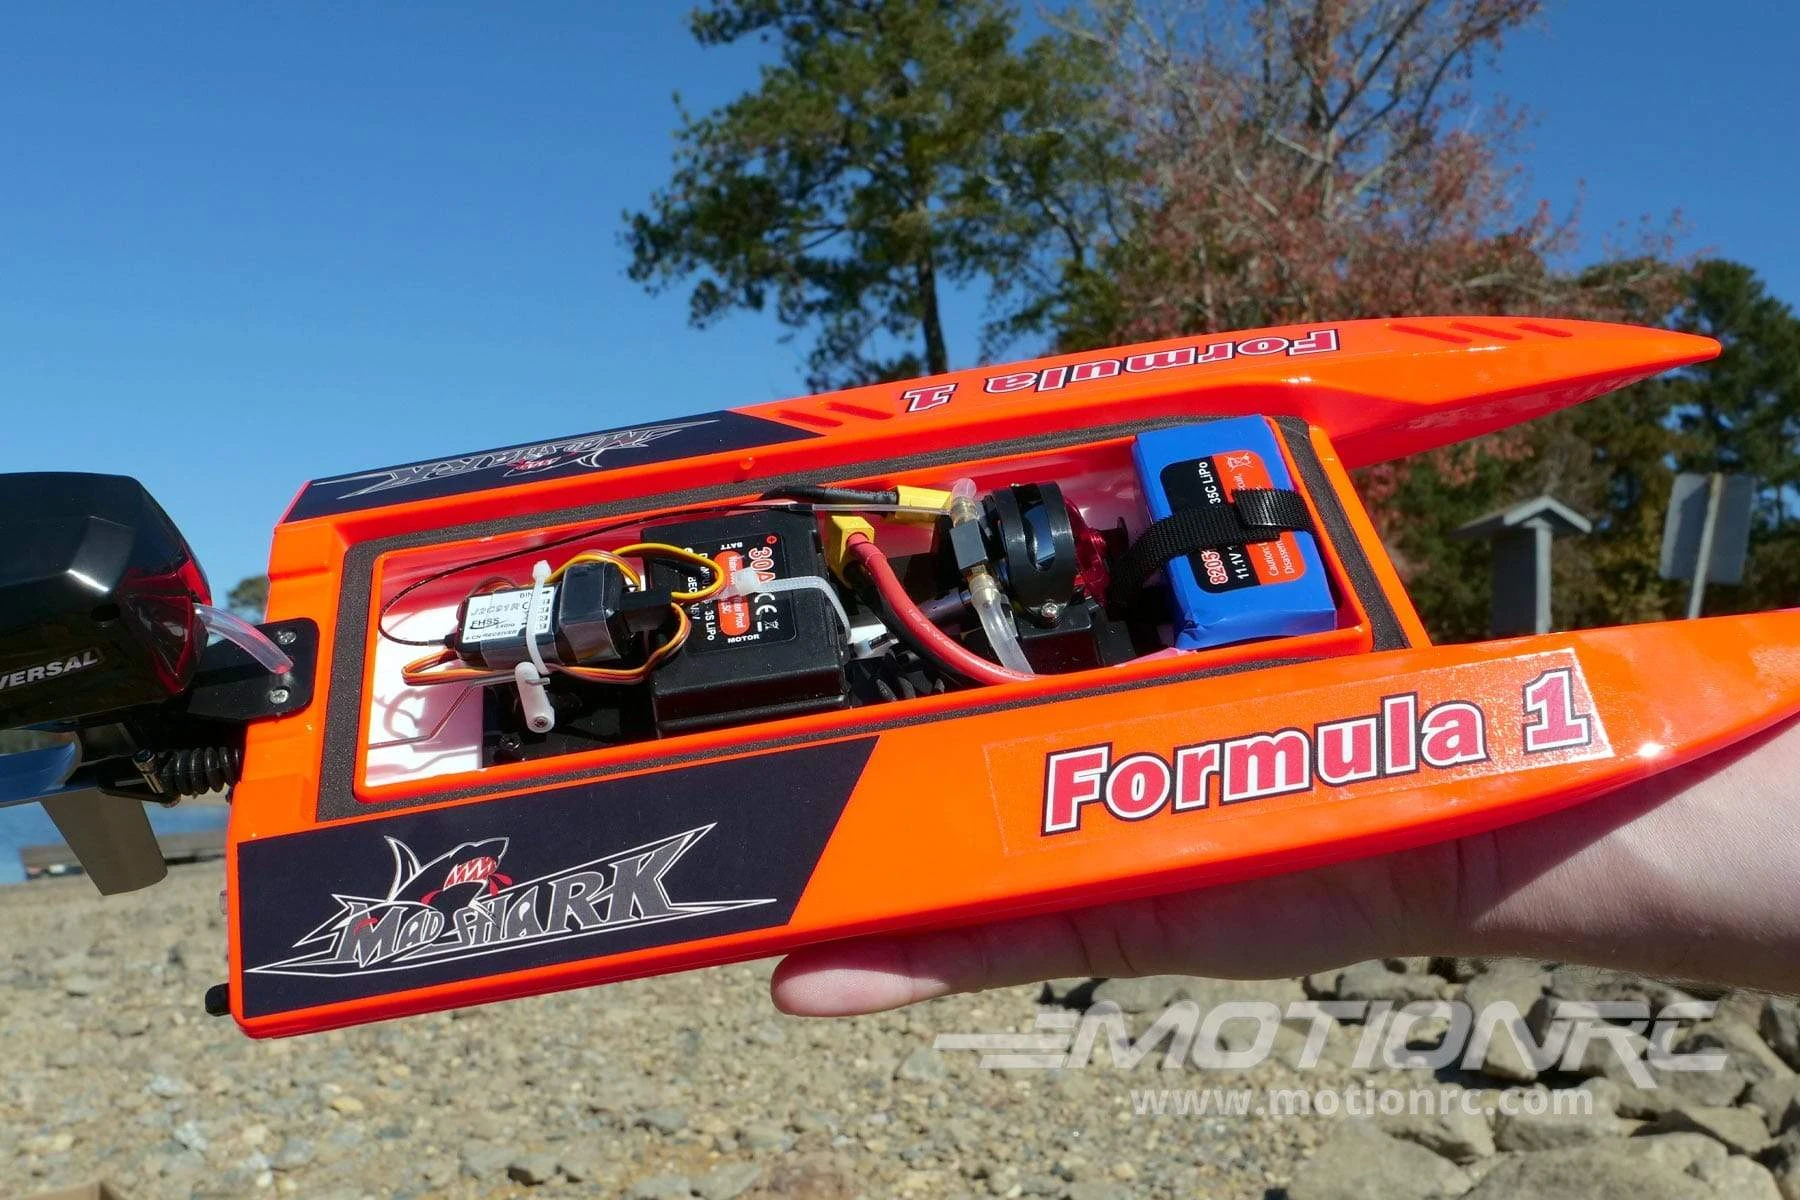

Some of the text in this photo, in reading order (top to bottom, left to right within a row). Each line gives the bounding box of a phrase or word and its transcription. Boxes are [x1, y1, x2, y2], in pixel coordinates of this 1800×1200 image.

[901, 328, 1341, 414] Formula 1
[1198, 461, 1221, 504] 35C LiPo
[720, 541, 743, 550] BATT
[748, 547, 776, 584] 30A
[1201, 550, 1229, 585] 8205
[1228, 553, 1250, 580] 11.1V
[704, 610, 715, 621] 3S
[705, 622, 717, 641] LiPo
[727, 634, 761, 644] MOTOR
[1041, 667, 1593, 837] Formula 1
